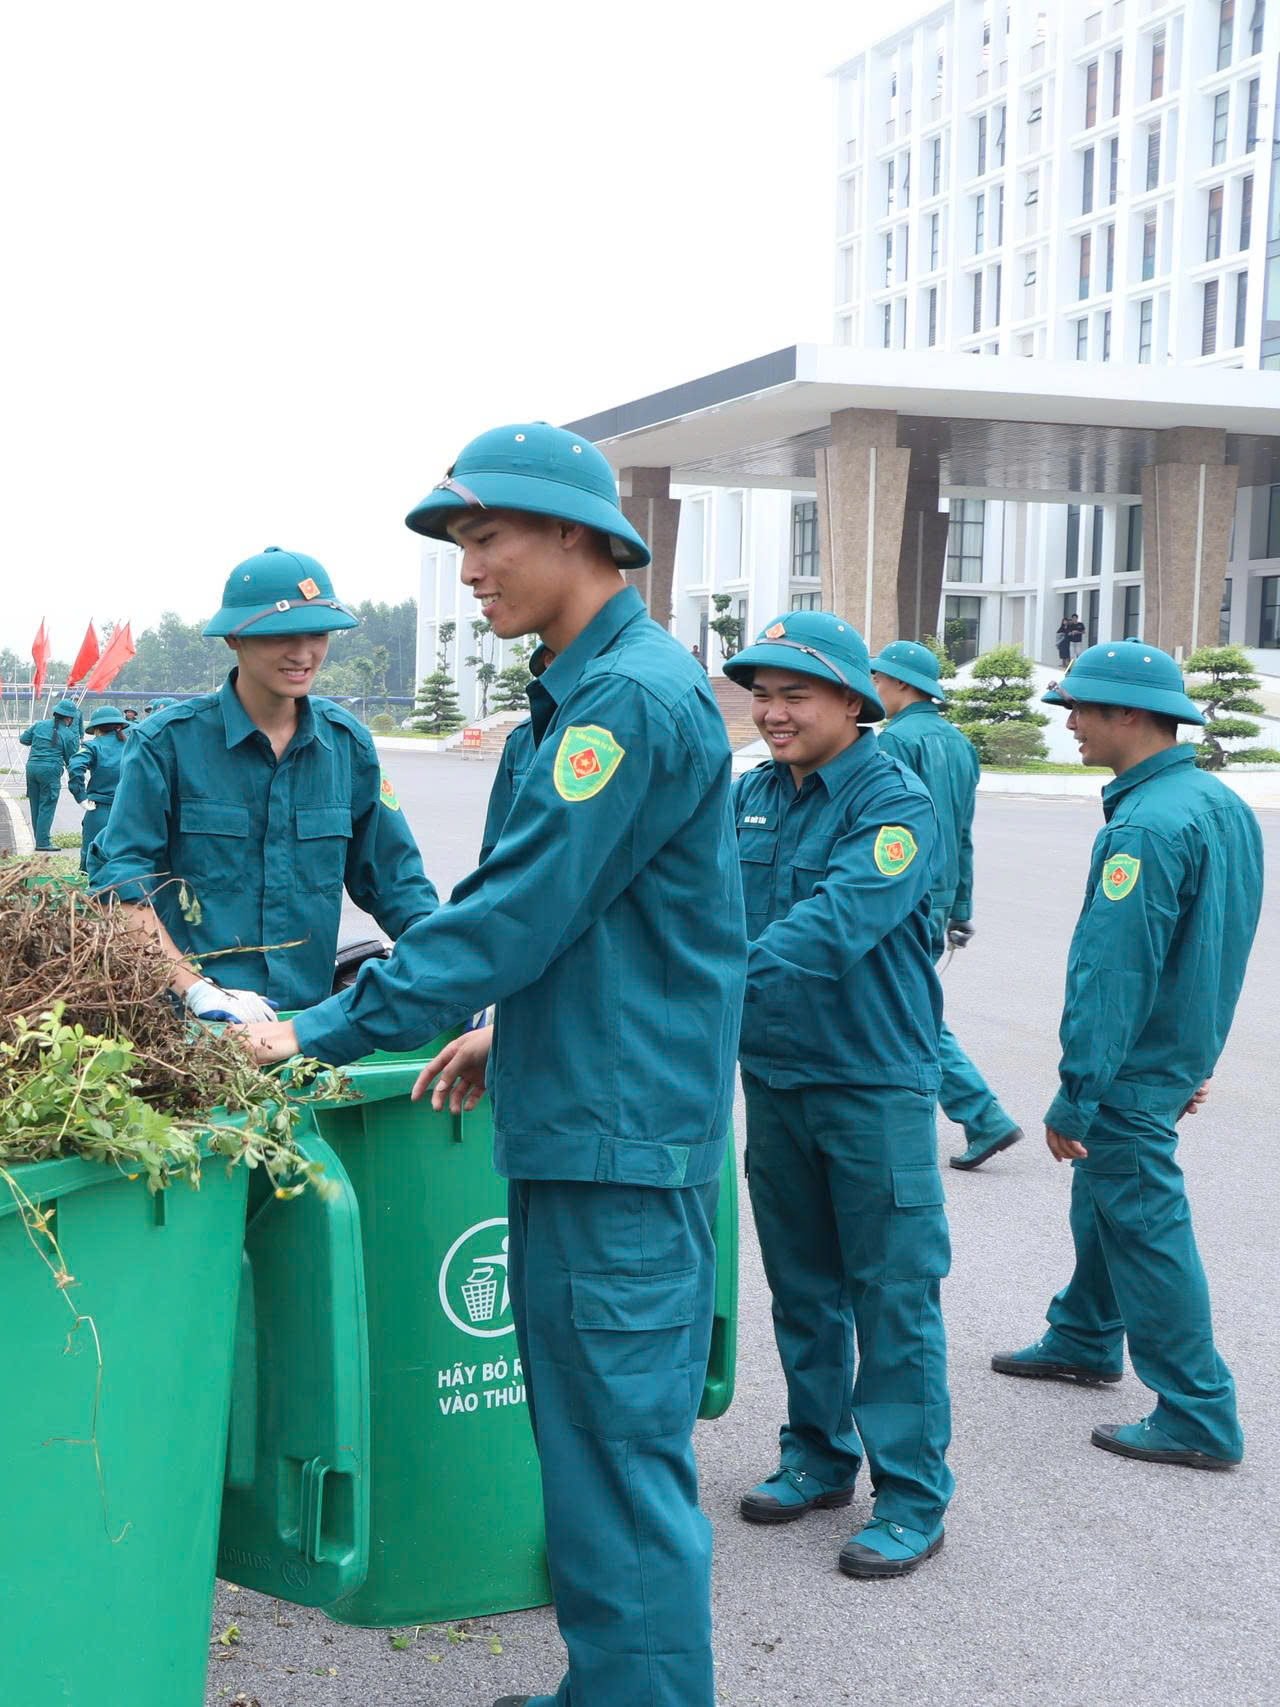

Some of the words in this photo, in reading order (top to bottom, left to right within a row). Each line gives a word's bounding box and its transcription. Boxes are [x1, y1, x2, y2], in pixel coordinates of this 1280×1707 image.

[438, 1362, 477, 1389] HÃY
[482, 1355, 508, 1382] BỎ
[439, 1389, 479, 1415] VÀO
[483, 1380, 527, 1409] THÙ
